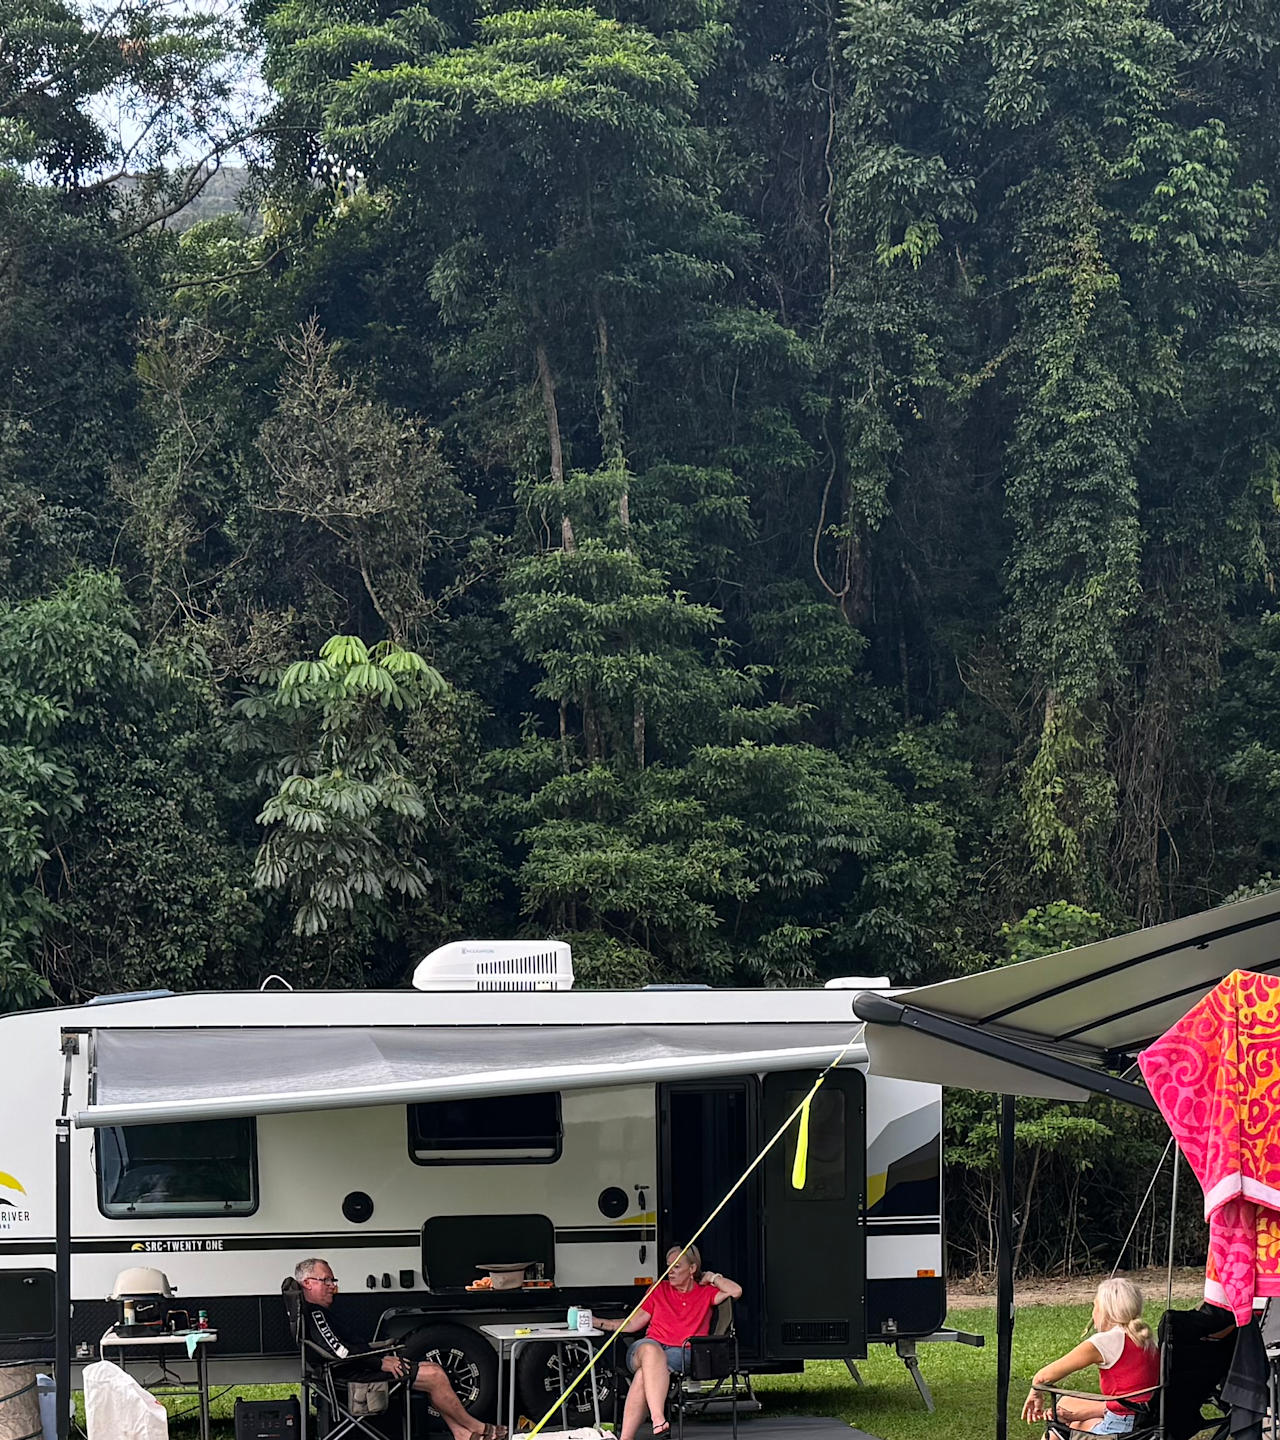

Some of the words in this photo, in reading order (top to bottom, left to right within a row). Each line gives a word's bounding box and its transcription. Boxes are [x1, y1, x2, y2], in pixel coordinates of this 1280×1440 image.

[1, 1211, 30, 1222] RIVER
[145, 1240, 203, 1252] SRC-TWENTY
[205, 1239, 224, 1251] ONE
